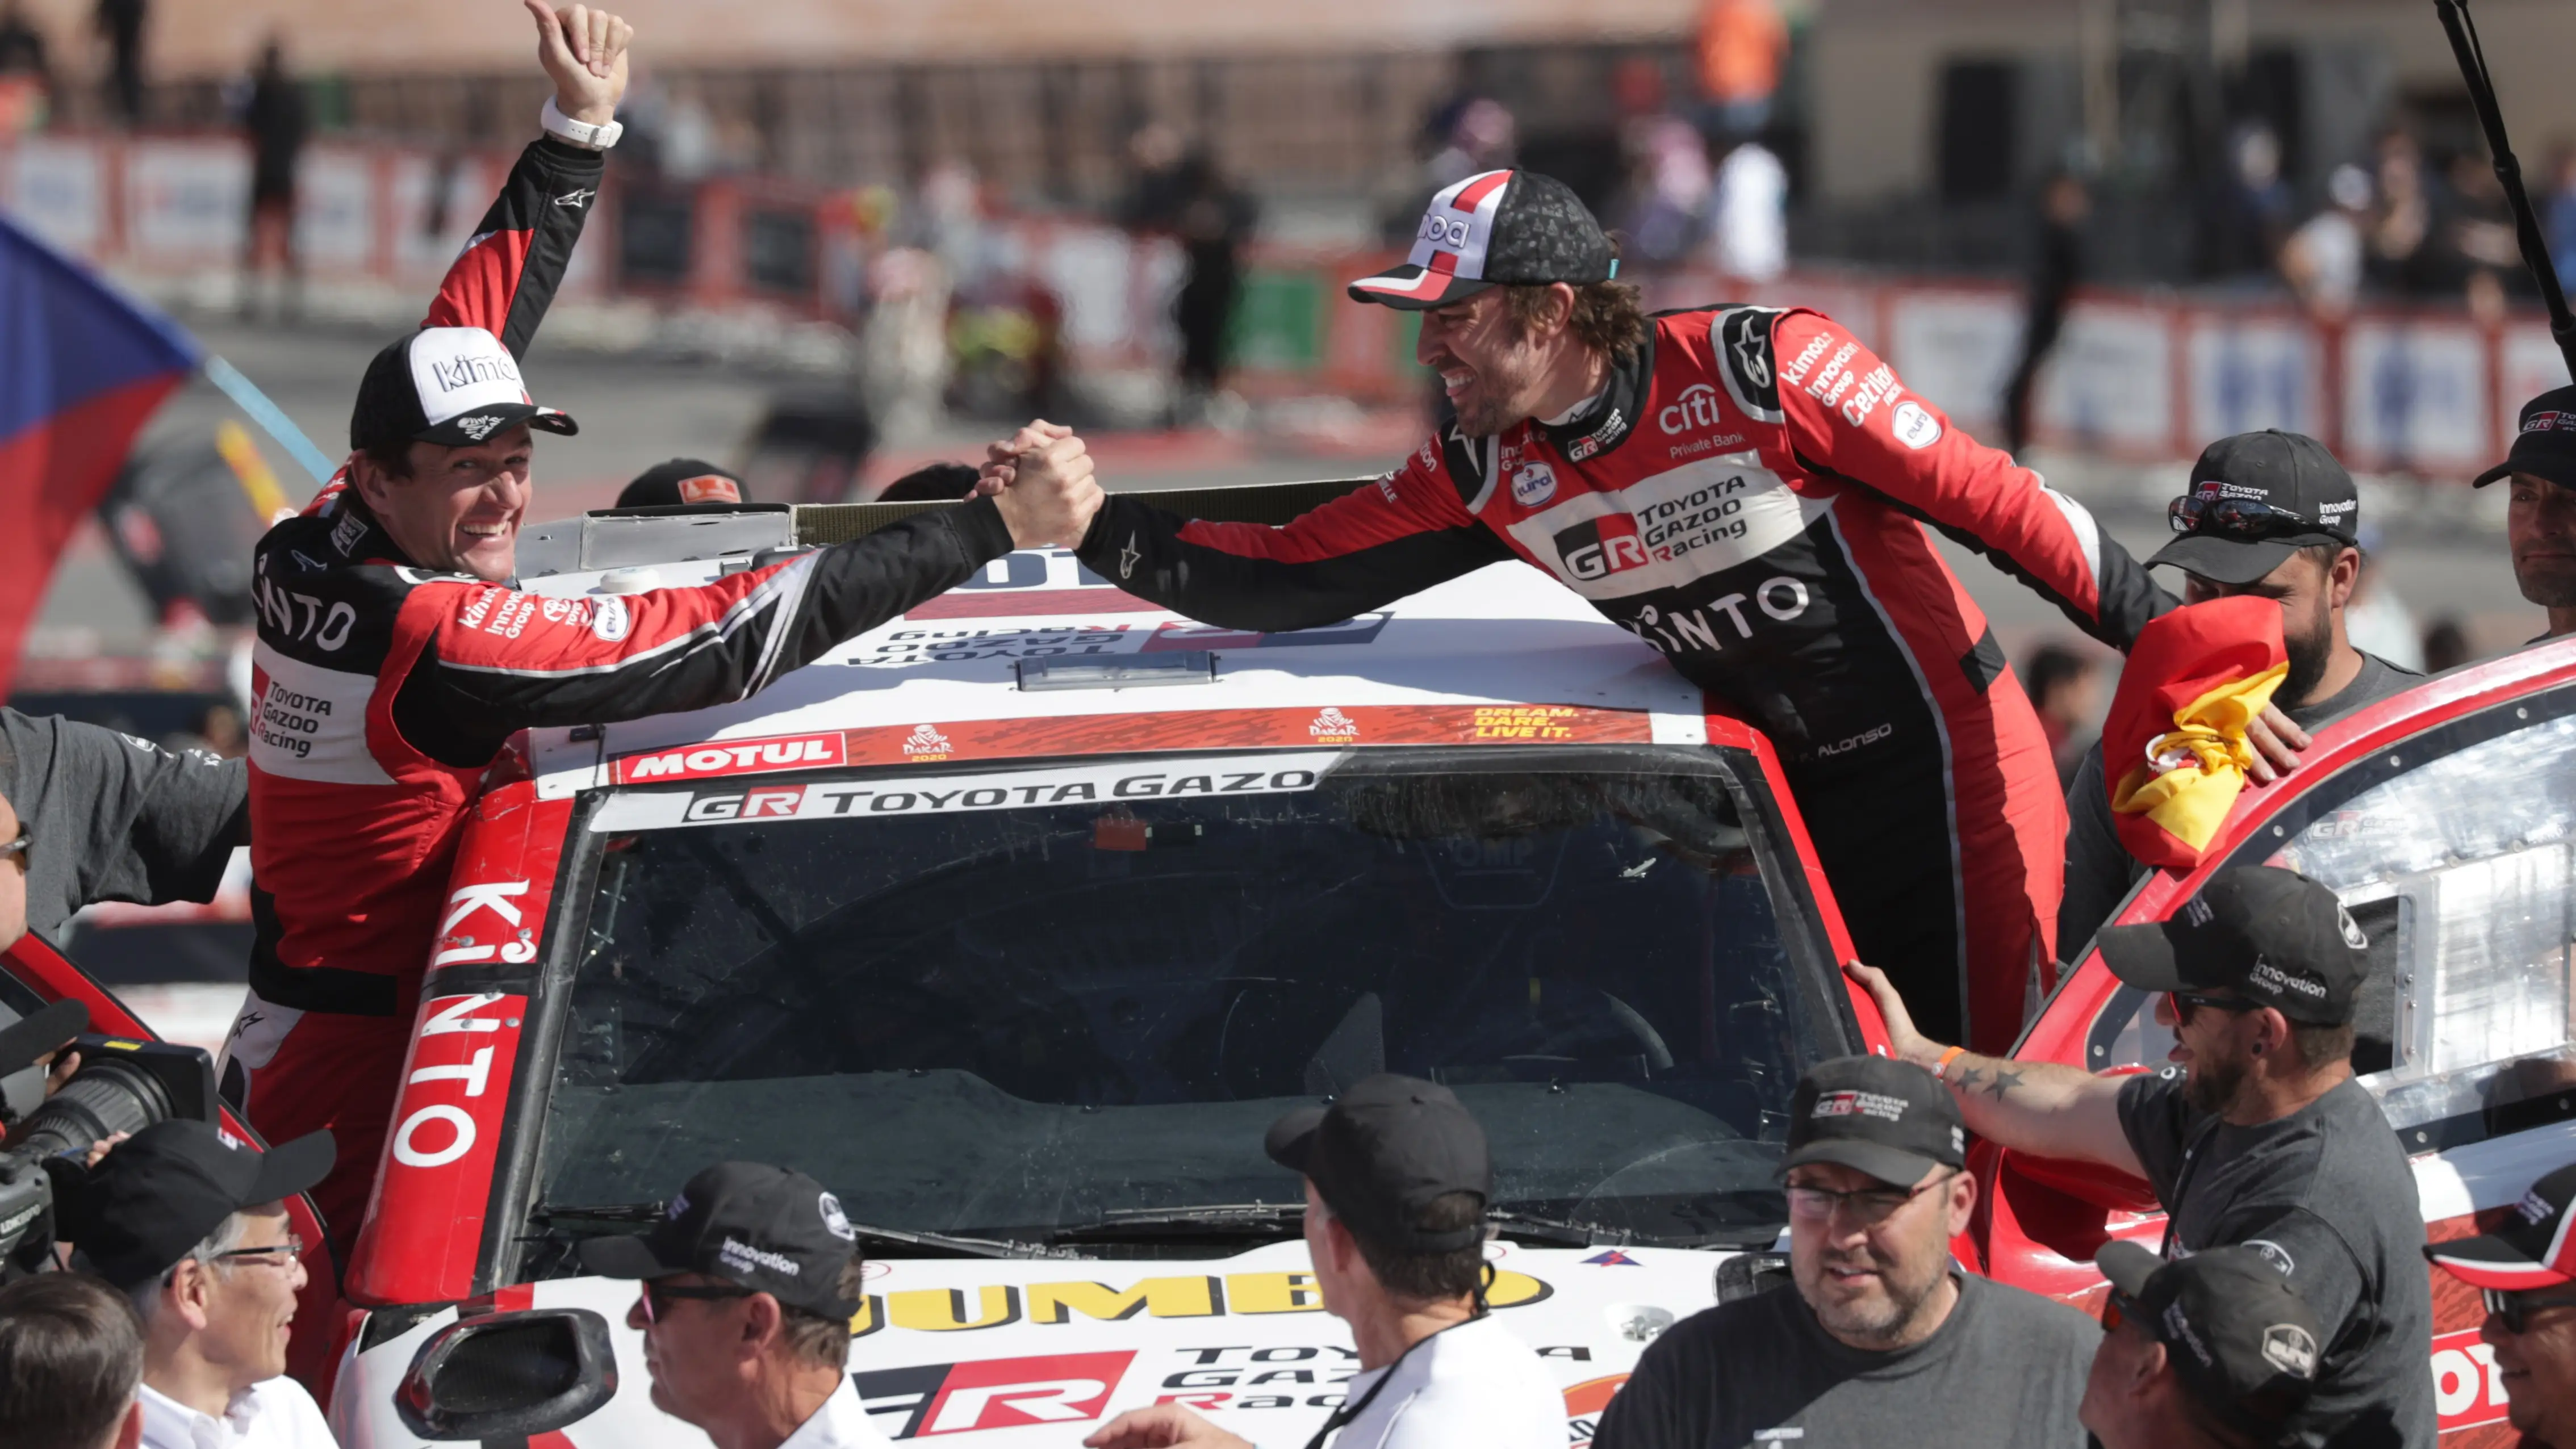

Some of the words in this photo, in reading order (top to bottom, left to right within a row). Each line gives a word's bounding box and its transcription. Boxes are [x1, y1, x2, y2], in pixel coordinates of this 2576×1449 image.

[1822, 370, 1854, 407] Group
[1842, 362, 1895, 427] Cetilar
[1659, 383, 1720, 435] citi
[1570, 440, 1598, 462] GR
[1670, 438, 1711, 459] Private
[1712, 432, 1746, 447] Bank
[1637, 475, 1747, 526] TOYOTA
[2222, 483, 2269, 496] TOYOTA
[1644, 499, 1743, 547] GAZOO
[1565, 535, 1646, 581] GR
[1651, 519, 1747, 564] Racing
[505, 602, 536, 639] Group
[847, 645, 1116, 665] TOYOTA
[875, 634, 1124, 652] GAZOO
[270, 681, 332, 716] TOYOTA
[1474, 708, 1579, 717] DREAM.
[262, 702, 319, 734] GAZOO
[1308, 724, 1361, 736] DAKAR
[1475, 717, 1555, 726] DARE.
[1477, 726, 1537, 738] LIVE
[1541, 727, 1573, 738] IT.
[258, 721, 311, 758] Racing
[902, 742, 954, 755] DAKAR
[631, 740, 833, 778] MOTUL
[911, 754, 947, 763] 2020
[687, 791, 802, 819] GR
[823, 782, 1095, 814] TOYOTA
[1111, 770, 1316, 798] GAZO
